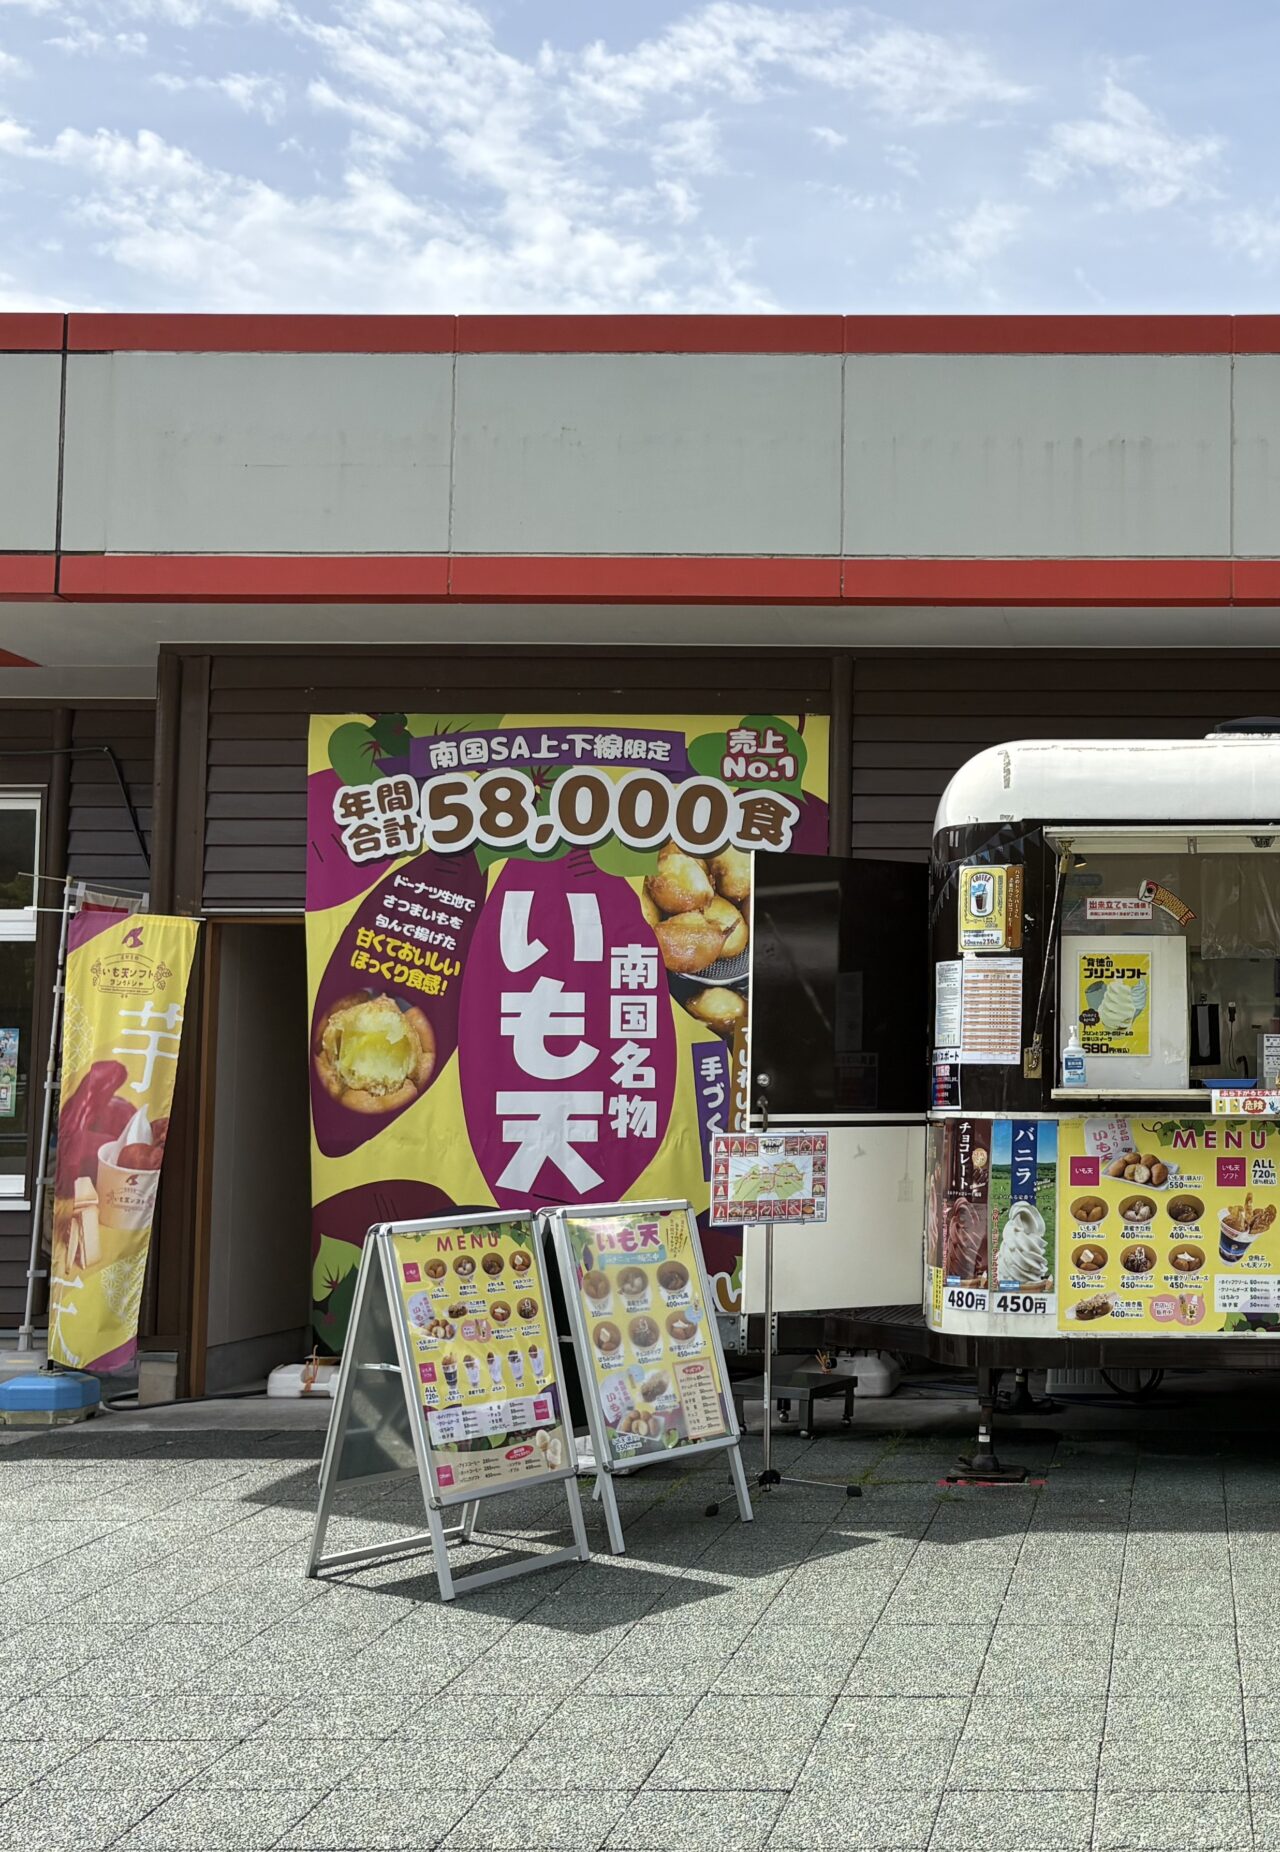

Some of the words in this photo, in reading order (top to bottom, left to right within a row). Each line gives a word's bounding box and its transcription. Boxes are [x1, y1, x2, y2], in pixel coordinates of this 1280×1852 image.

[728, 729, 786, 755] 売上
[722, 754, 795, 780] No.1
[338, 779, 415, 819] 年間
[347, 813, 419, 856] 合計
[393, 873, 476, 911] ドーナツ生地で
[382, 892, 464, 930] さつまいもを
[375, 913, 457, 951] 包んで揚げた
[355, 927, 462, 977] 甘くておいしい
[102, 967, 154, 980] いも天ソフト
[1083, 968, 1147, 979] プリンソフト
[112, 1000, 184, 1093] 芋
[495, 890, 604, 1194] いも天
[608, 943, 658, 1138] 南国名物
[700, 1055, 725, 1155] 手づく
[1244, 1100, 1264, 1111] 危険
[1173, 1130, 1266, 1149] MENU
[959, 1121, 972, 1191] チョコレート
[1014, 1126, 1035, 1185] バニラ
[1252, 1159, 1275, 1169] ALL
[1075, 1167, 1094, 1175] いも天
[1252, 1170, 1276, 1179] 720円
[437, 1232, 499, 1252] MENU
[596, 1223, 662, 1252] いも天
[948, 1289, 986, 1311] 480円
[996, 1295, 1047, 1314] 450円
